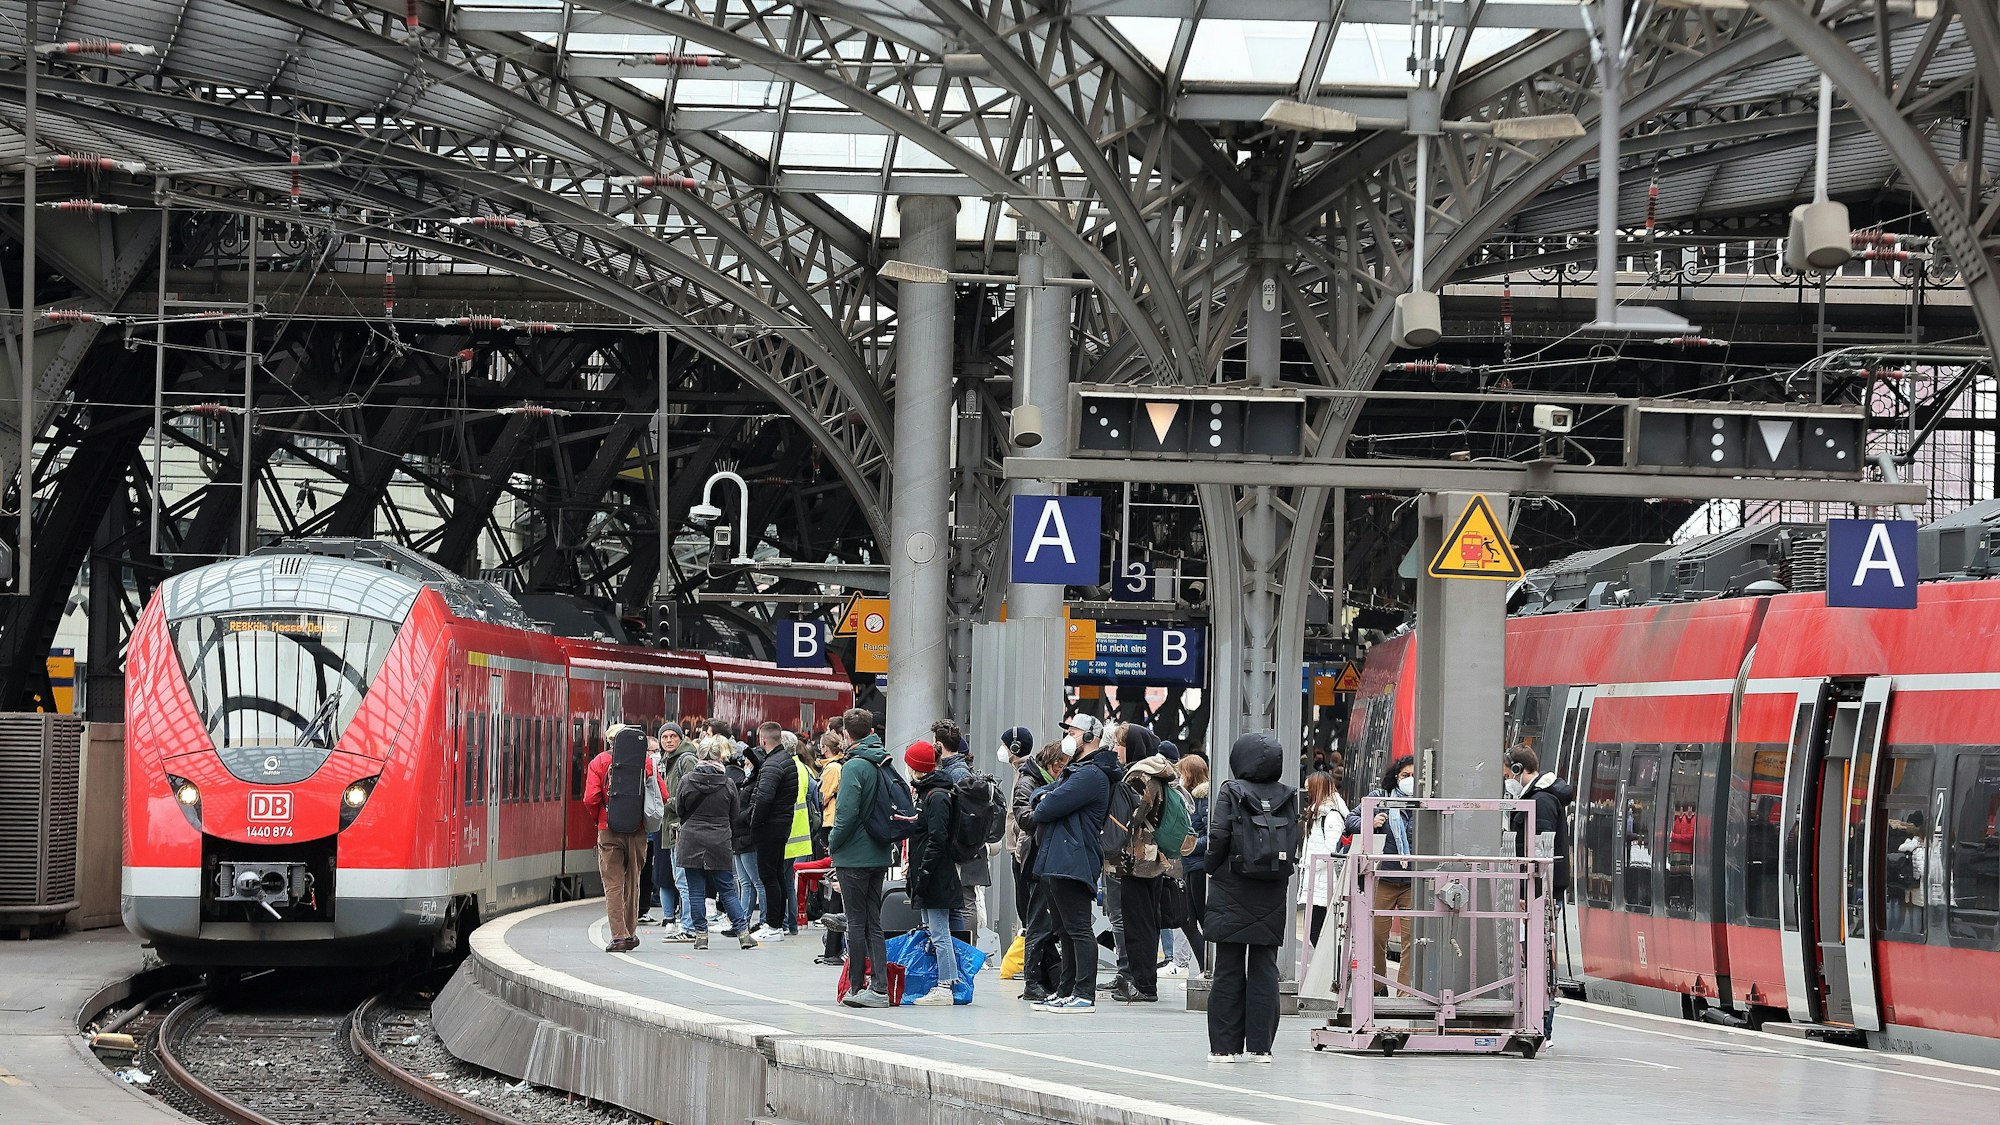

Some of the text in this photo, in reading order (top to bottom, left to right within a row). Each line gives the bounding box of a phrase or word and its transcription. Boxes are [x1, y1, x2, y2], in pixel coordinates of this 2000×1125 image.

[1024, 500, 1077, 564] A
[1851, 523, 1905, 587] A
[1126, 562, 1147, 593] 3
[793, 622, 818, 658] B
[1109, 643, 1129, 653] nicht
[1162, 630, 1188, 666] B
[254, 796, 287, 816] DB
[1935, 791, 1944, 832] 2
[246, 826, 294, 837] 1440 874
